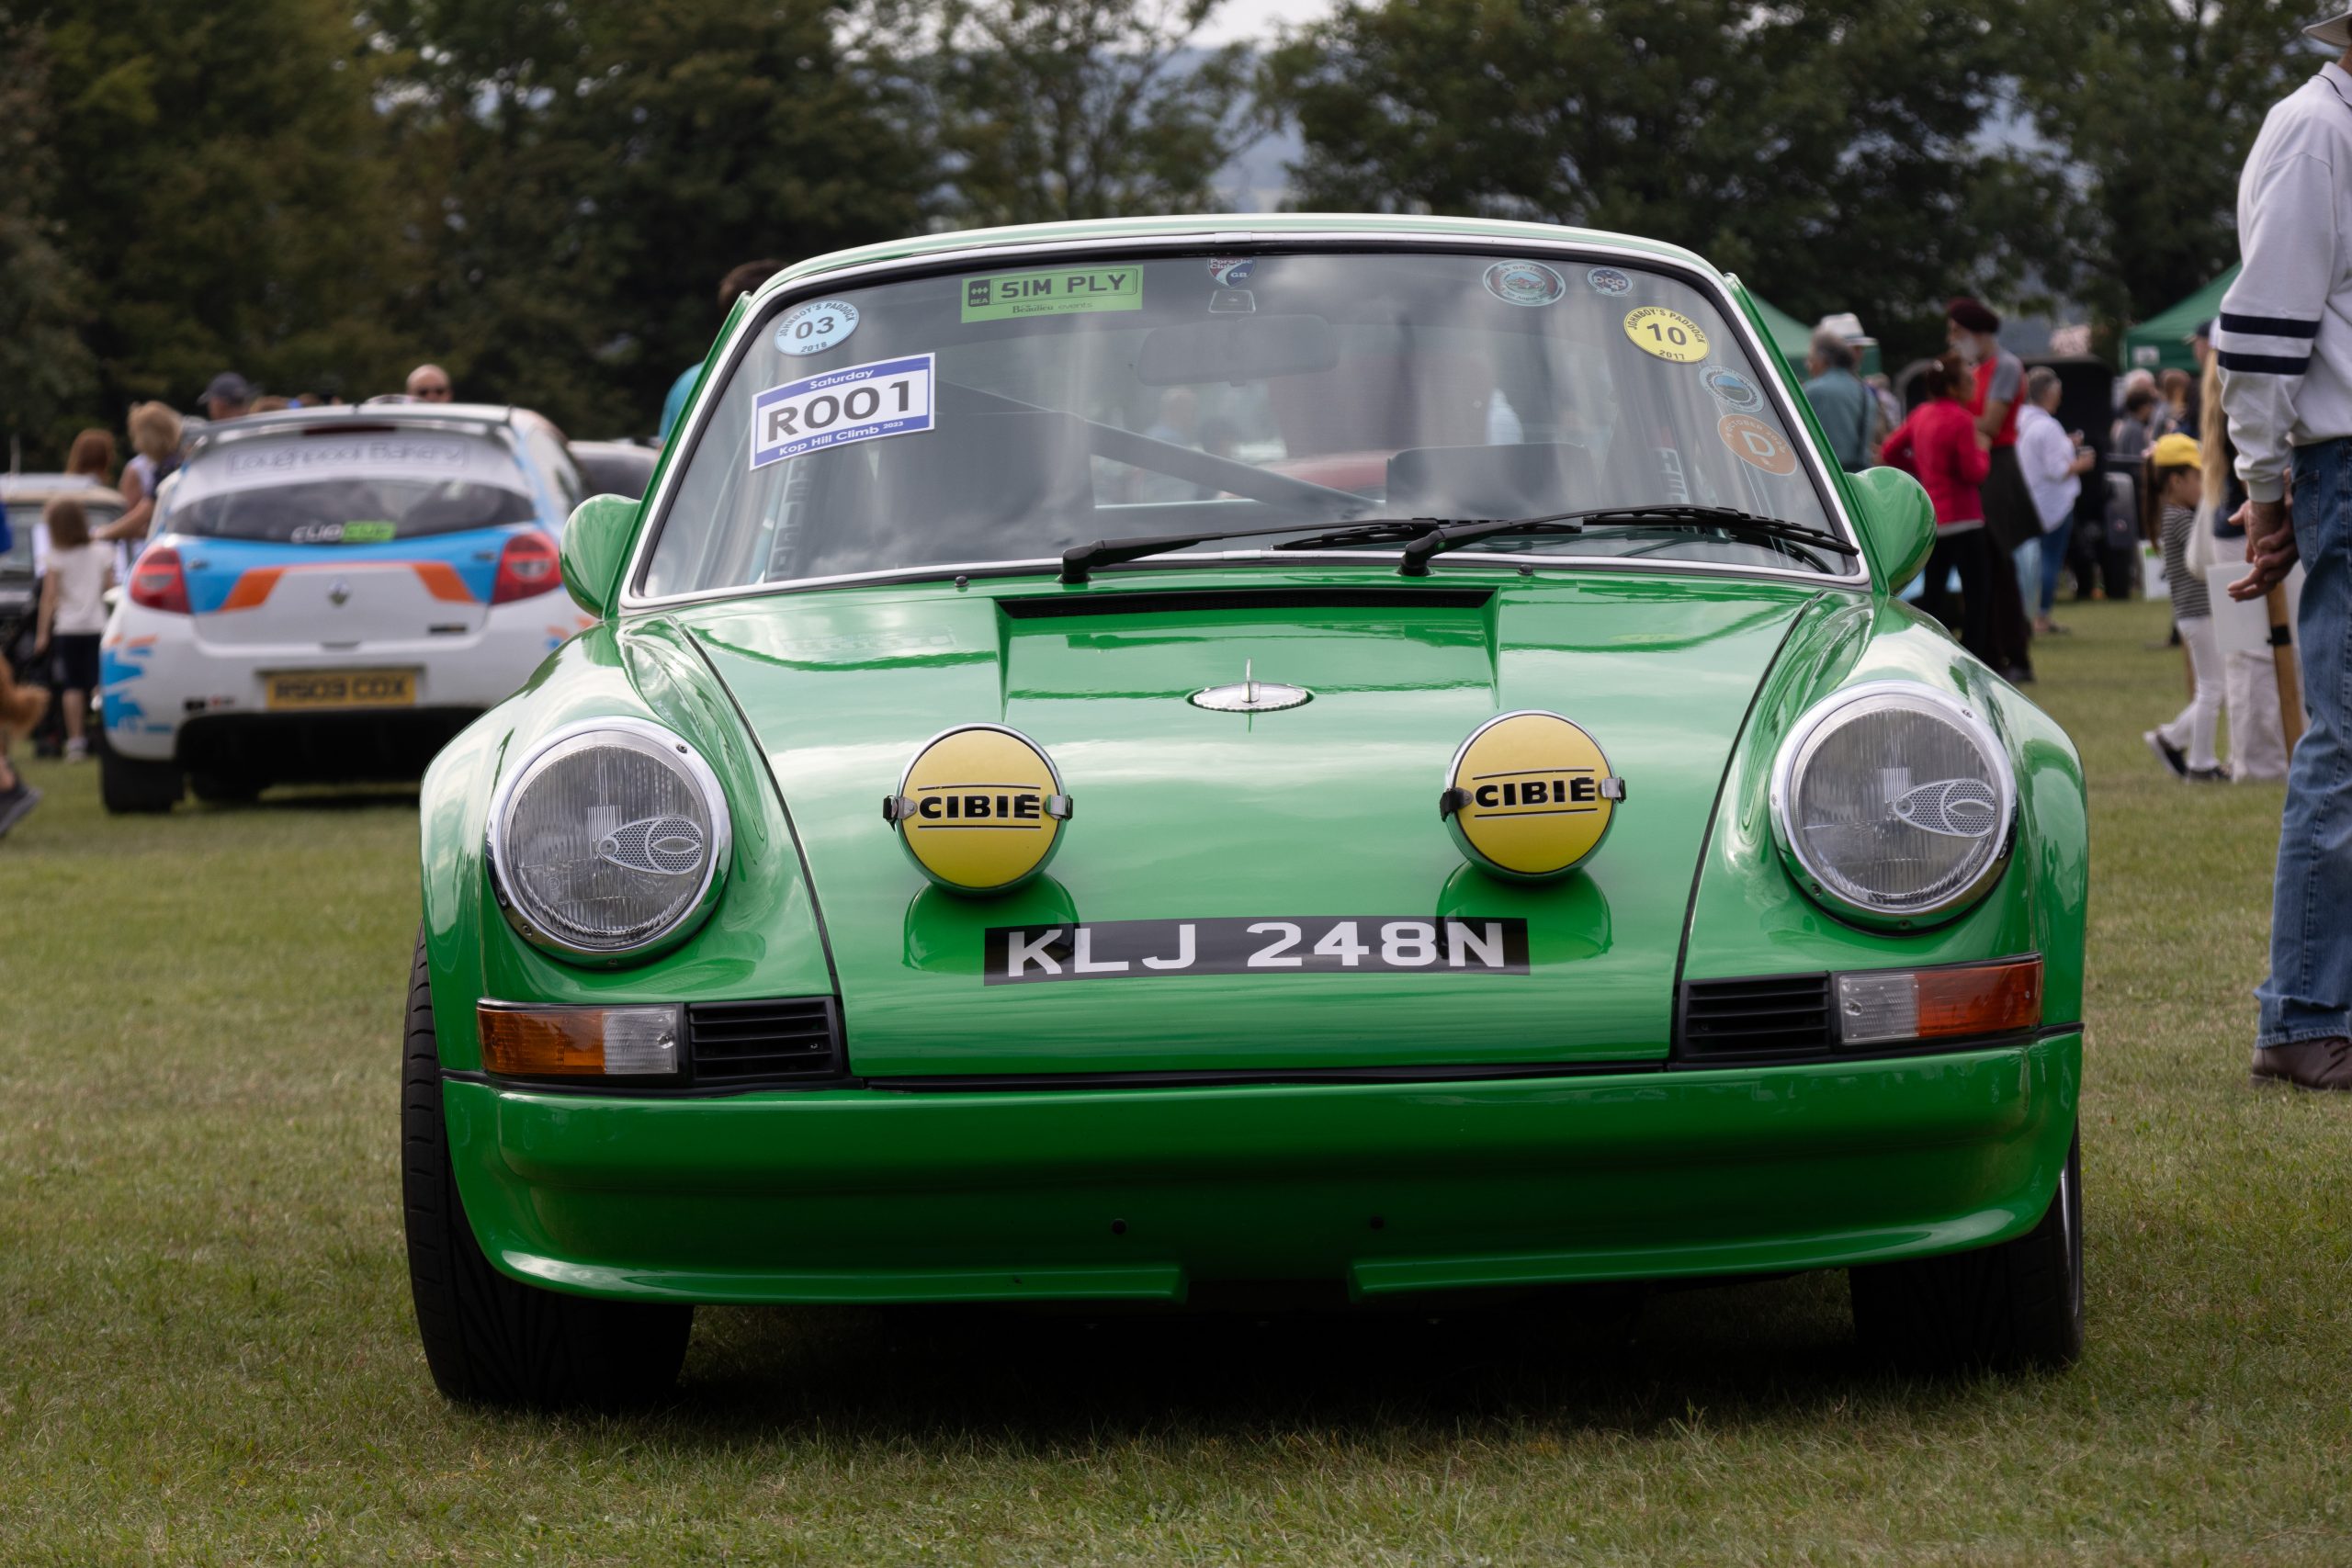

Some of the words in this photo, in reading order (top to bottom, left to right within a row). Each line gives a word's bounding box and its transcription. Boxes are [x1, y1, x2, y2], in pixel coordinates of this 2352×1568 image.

[1067, 274, 1126, 294] PLY
[970, 298, 989, 306] BEA
[1012, 304, 1054, 314] Beaulieu
[1057, 302, 1093, 310] events
[779, 303, 822, 337] JOHNBOY'S
[824, 302, 855, 322] PADDOCK
[796, 316, 834, 339] 03
[1628, 308, 1666, 330] JOHNBOY'S
[1669, 312, 1706, 344] PADDOCK
[1646, 323, 1687, 345] 10
[1658, 349, 1685, 360] 2017
[809, 369, 874, 390] Saturday
[779, 443, 808, 456] Kop
[811, 434, 831, 447] Hill
[836, 426, 879, 441] Climb
[883, 421, 904, 429] 2023
[1741, 430, 1775, 457] D
[1476, 777, 1595, 807] CIBIÉ
[920, 795, 1040, 819] CIBIÉ
[1008, 923, 1196, 976] KLJ
[1246, 920, 1504, 968] 248N
